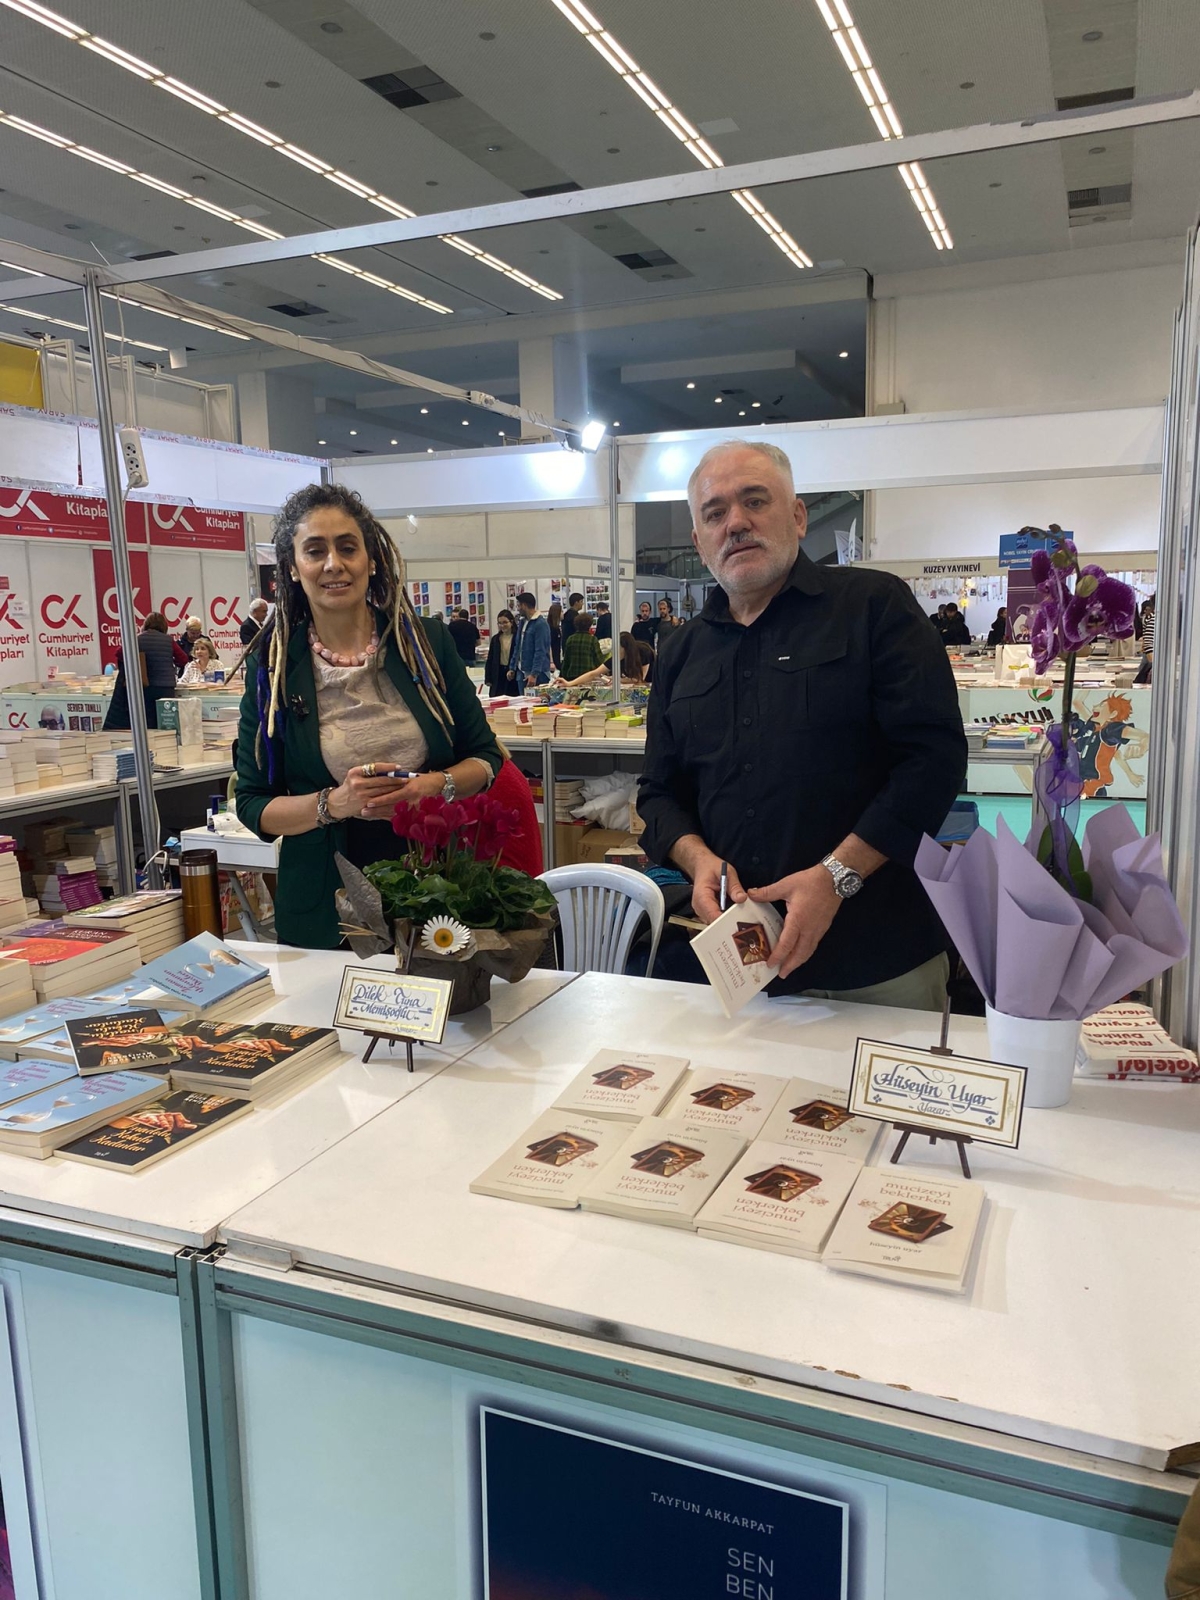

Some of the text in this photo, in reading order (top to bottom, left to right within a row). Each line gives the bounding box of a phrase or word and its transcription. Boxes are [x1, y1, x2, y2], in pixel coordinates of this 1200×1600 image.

[66, 501, 109, 520] Kitapla
[923, 561, 981, 574] KUZEY YAYINEVİ
[0, 634, 30, 646] uriyet
[38, 632, 94, 646] Cumhuriyet
[0, 648, 25, 662] pları
[46, 646, 89, 659] Kitapları
[585, 1089, 641, 1100] beklerken
[873, 1063, 998, 1114] Hüseyin Uyar
[582, 1094, 635, 1105] mucizeyi
[684, 1109, 743, 1121] beklerken
[916, 1102, 951, 1116] Yazar
[683, 1114, 738, 1127] mucizeyi
[783, 1135, 842, 1148] mucizeyi
[785, 1128, 848, 1144] beklerken
[506, 1171, 565, 1186] mucizeyi
[512, 1165, 574, 1179] beklerken
[615, 1183, 678, 1198] mucizeyi
[620, 1175, 686, 1191] beklerken
[885, 1182, 952, 1198] mucizeyi
[879, 1187, 952, 1206] beklerken
[732, 1205, 799, 1223] mucizeyi
[736, 1198, 806, 1217] beklerken
[650, 1492, 775, 1536] TAYFUN AKKARPAT
[727, 1547, 775, 1578] SEN
[726, 1573, 774, 1600] BEN
